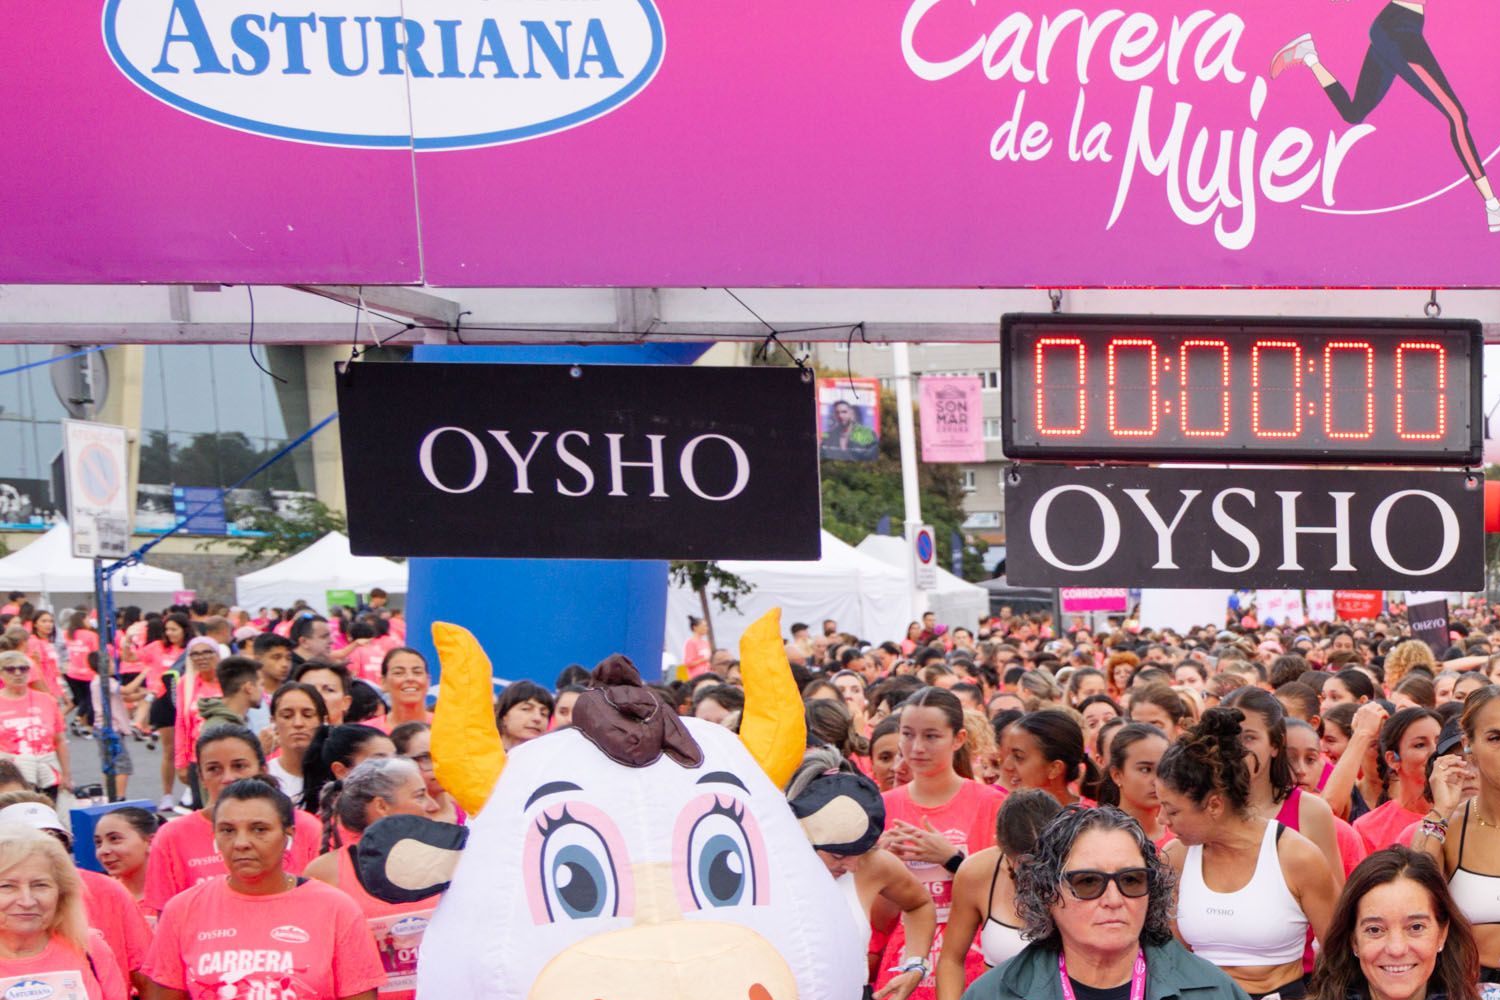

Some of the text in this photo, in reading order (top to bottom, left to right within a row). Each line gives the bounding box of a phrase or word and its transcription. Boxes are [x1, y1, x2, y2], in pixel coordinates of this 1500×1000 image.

[152, 0, 624, 79] ASTURIANA
[901, 0, 1246, 84] Carrera
[990, 75, 1377, 250] de la Mujer
[935, 400, 967, 412] SON
[936, 413, 968, 424] MAR
[419, 426, 750, 500] OYSHO
[1029, 484, 1460, 576] OYSHO
